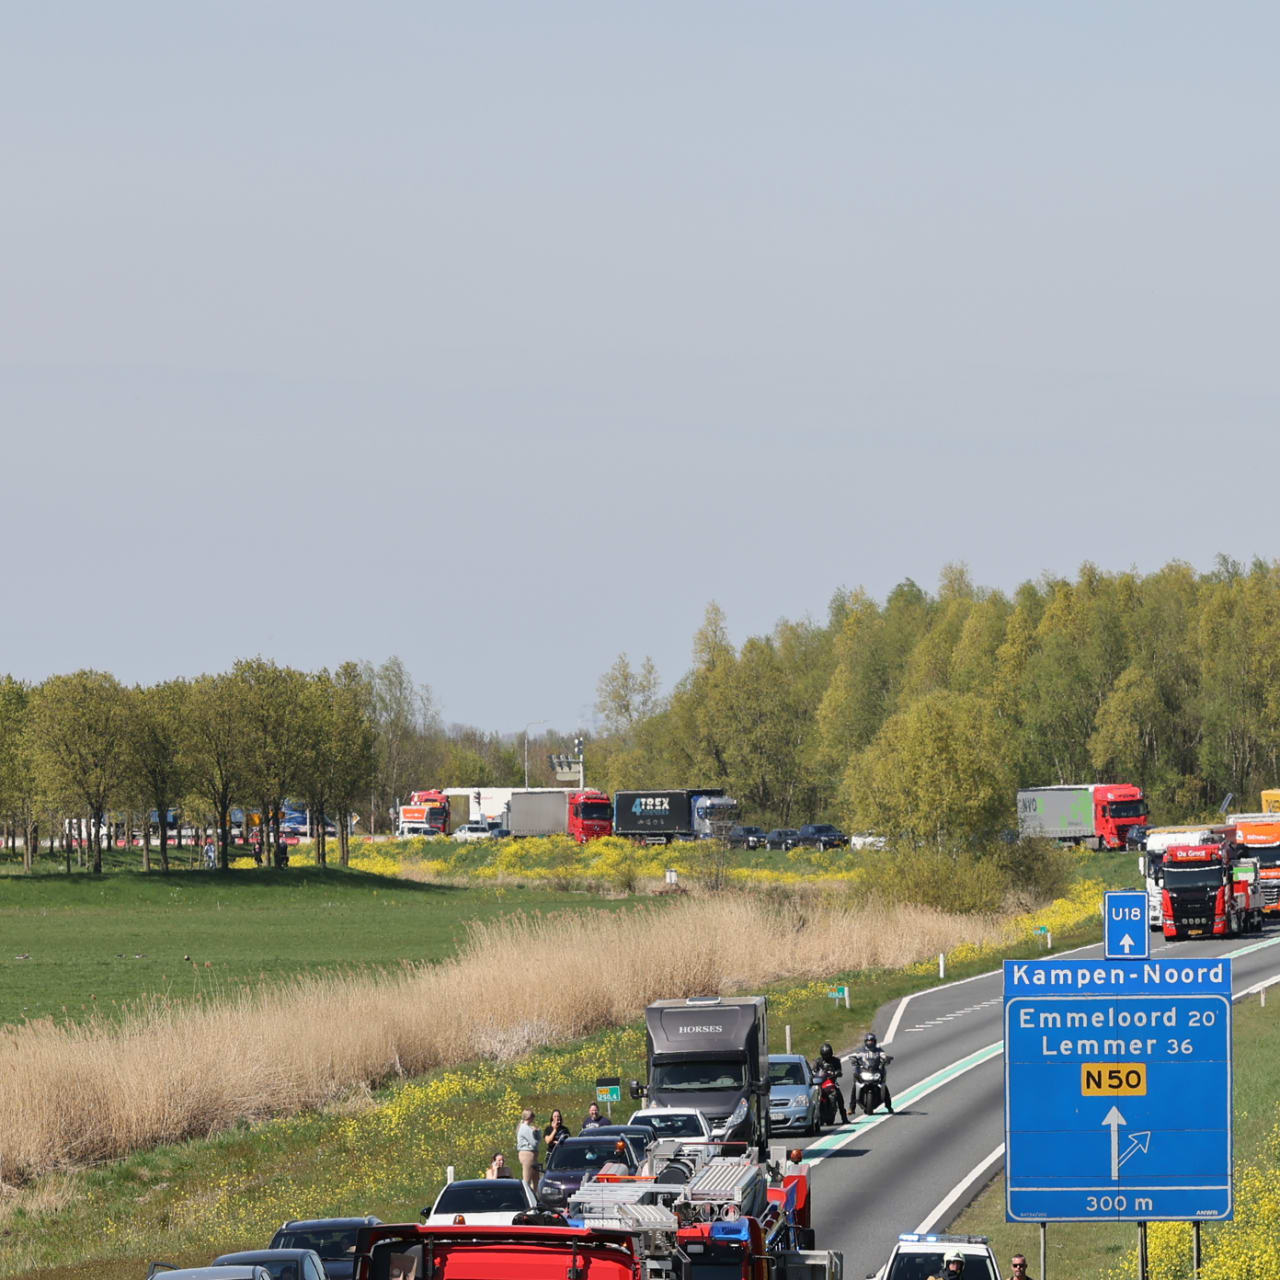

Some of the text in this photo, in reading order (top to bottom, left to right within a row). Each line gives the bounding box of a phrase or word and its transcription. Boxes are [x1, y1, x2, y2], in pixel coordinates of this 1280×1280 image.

[1112, 907, 1141, 920] U18
[1013, 963, 1223, 988] Kampen-Noord
[1020, 1007, 1215, 1028] Emmeloord 20
[1042, 1036, 1193, 1056] Lemmer 36
[1086, 1196, 1153, 1211] 300 m
